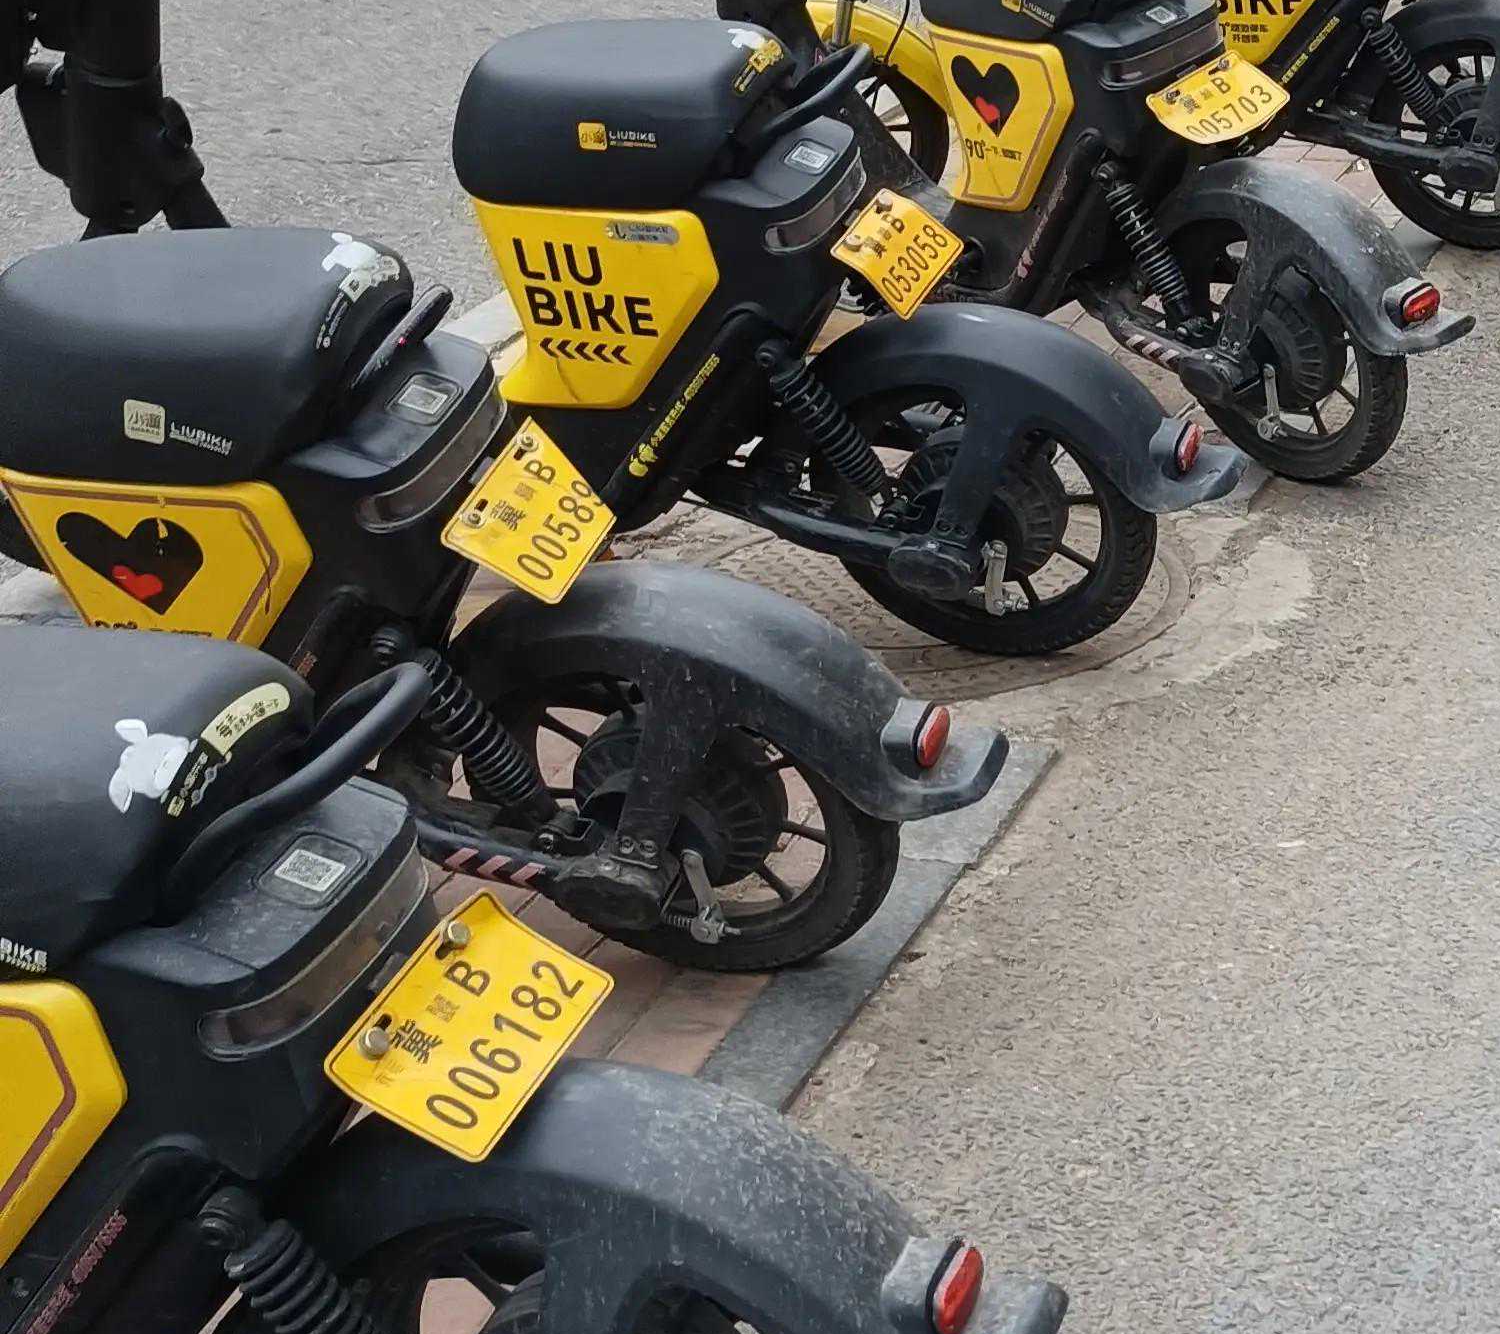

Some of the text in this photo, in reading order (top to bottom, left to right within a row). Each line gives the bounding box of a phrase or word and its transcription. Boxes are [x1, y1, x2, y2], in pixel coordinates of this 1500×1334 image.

[1186, 85, 1273, 139] 005703
[1211, 77, 1232, 95] B
[881, 213, 905, 233] B
[512, 237, 602, 286] LIU
[881, 224, 948, 303] 053058
[524, 284, 659, 337] BIKE
[523, 459, 556, 485] B
[388, 960, 491, 1065] 冀 B
[425, 960, 585, 1130] 006182
